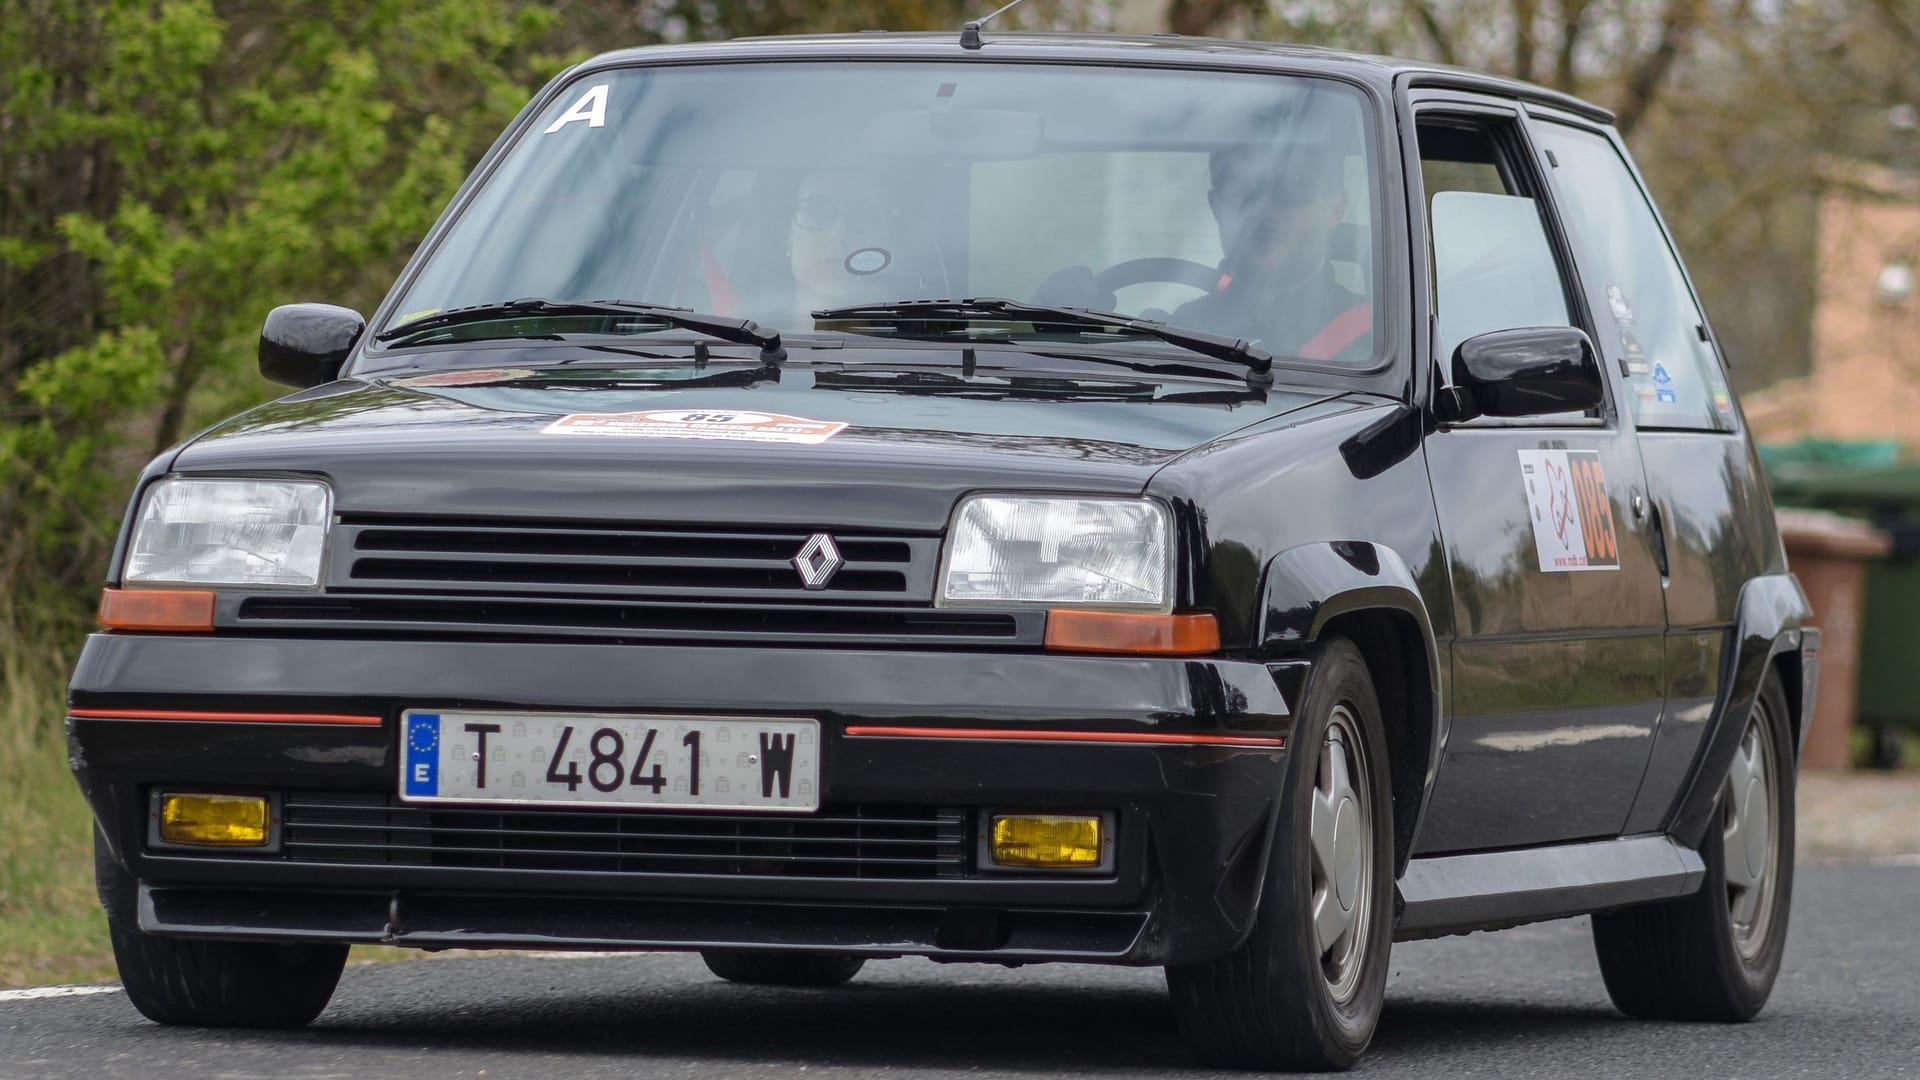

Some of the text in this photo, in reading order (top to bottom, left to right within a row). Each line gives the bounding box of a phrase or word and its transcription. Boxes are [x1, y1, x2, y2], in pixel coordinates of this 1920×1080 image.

[544, 84, 609, 134] A
[680, 413, 734, 422] 85
[1571, 460, 1616, 559] 085
[415, 764, 429, 782] E
[464, 723, 795, 798] T 4841 W
